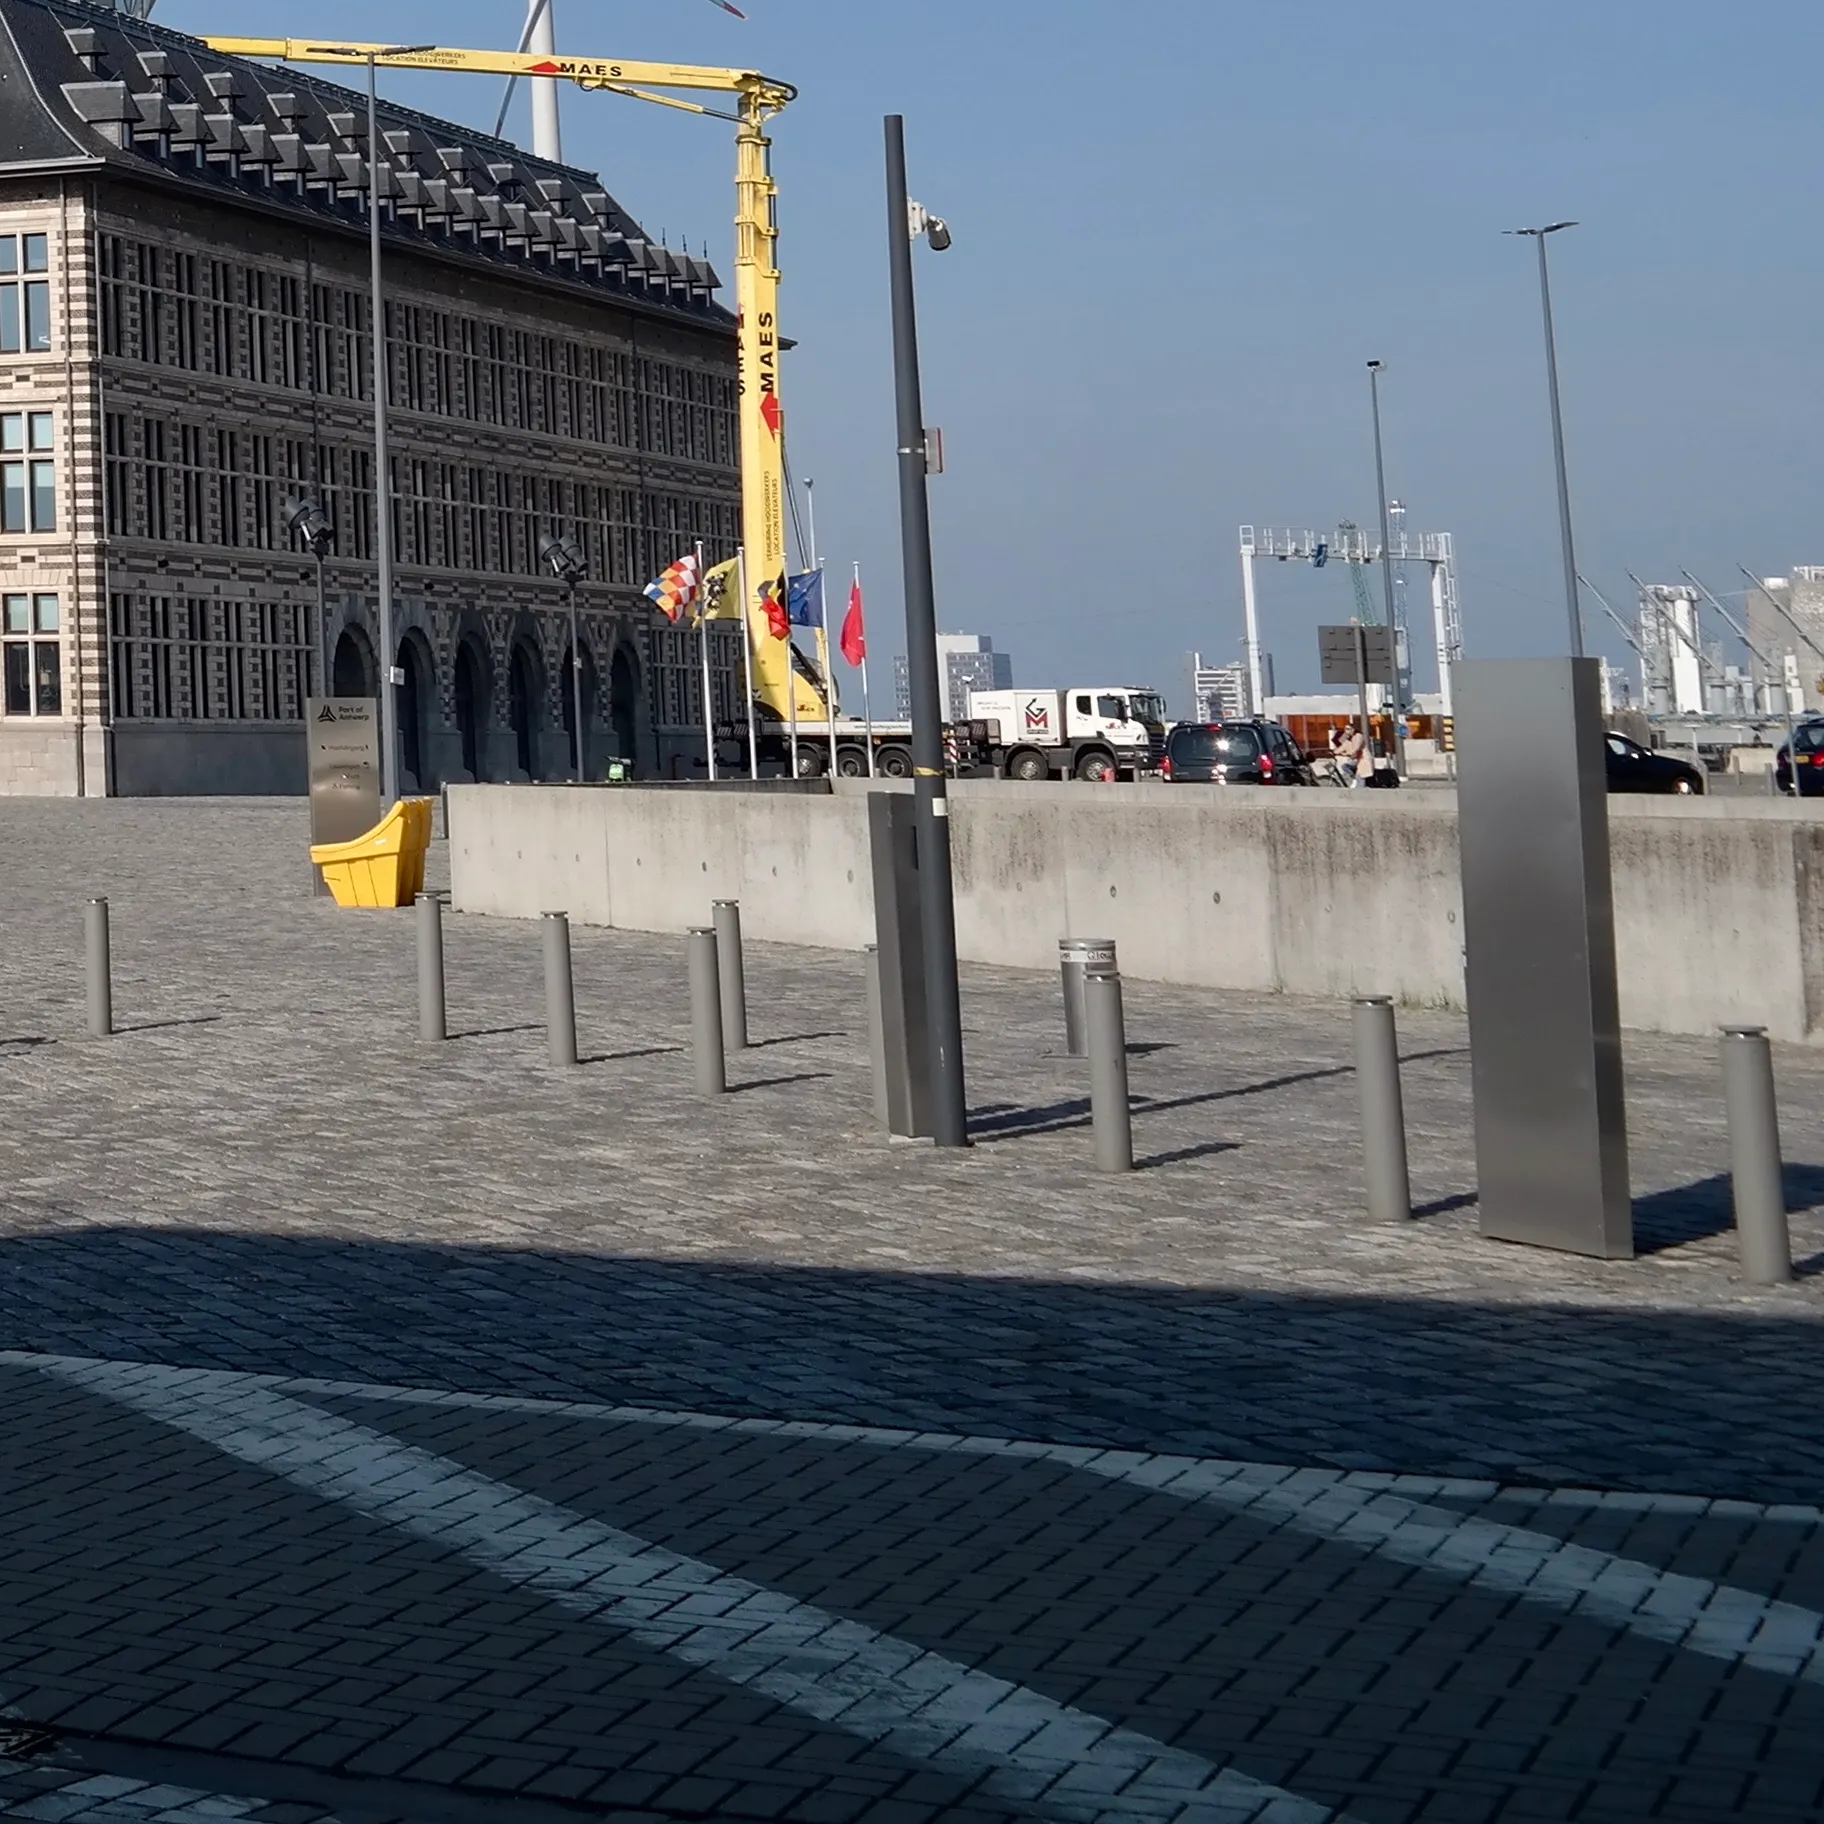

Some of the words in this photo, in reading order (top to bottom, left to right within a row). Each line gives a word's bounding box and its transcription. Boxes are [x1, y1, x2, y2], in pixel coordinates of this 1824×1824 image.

[560, 62, 622, 77] MAES
[758, 311, 774, 393] MAES
[338, 706, 354, 714] Port
[355, 705, 364, 713] of
[338, 714, 370, 722] Antwerp
